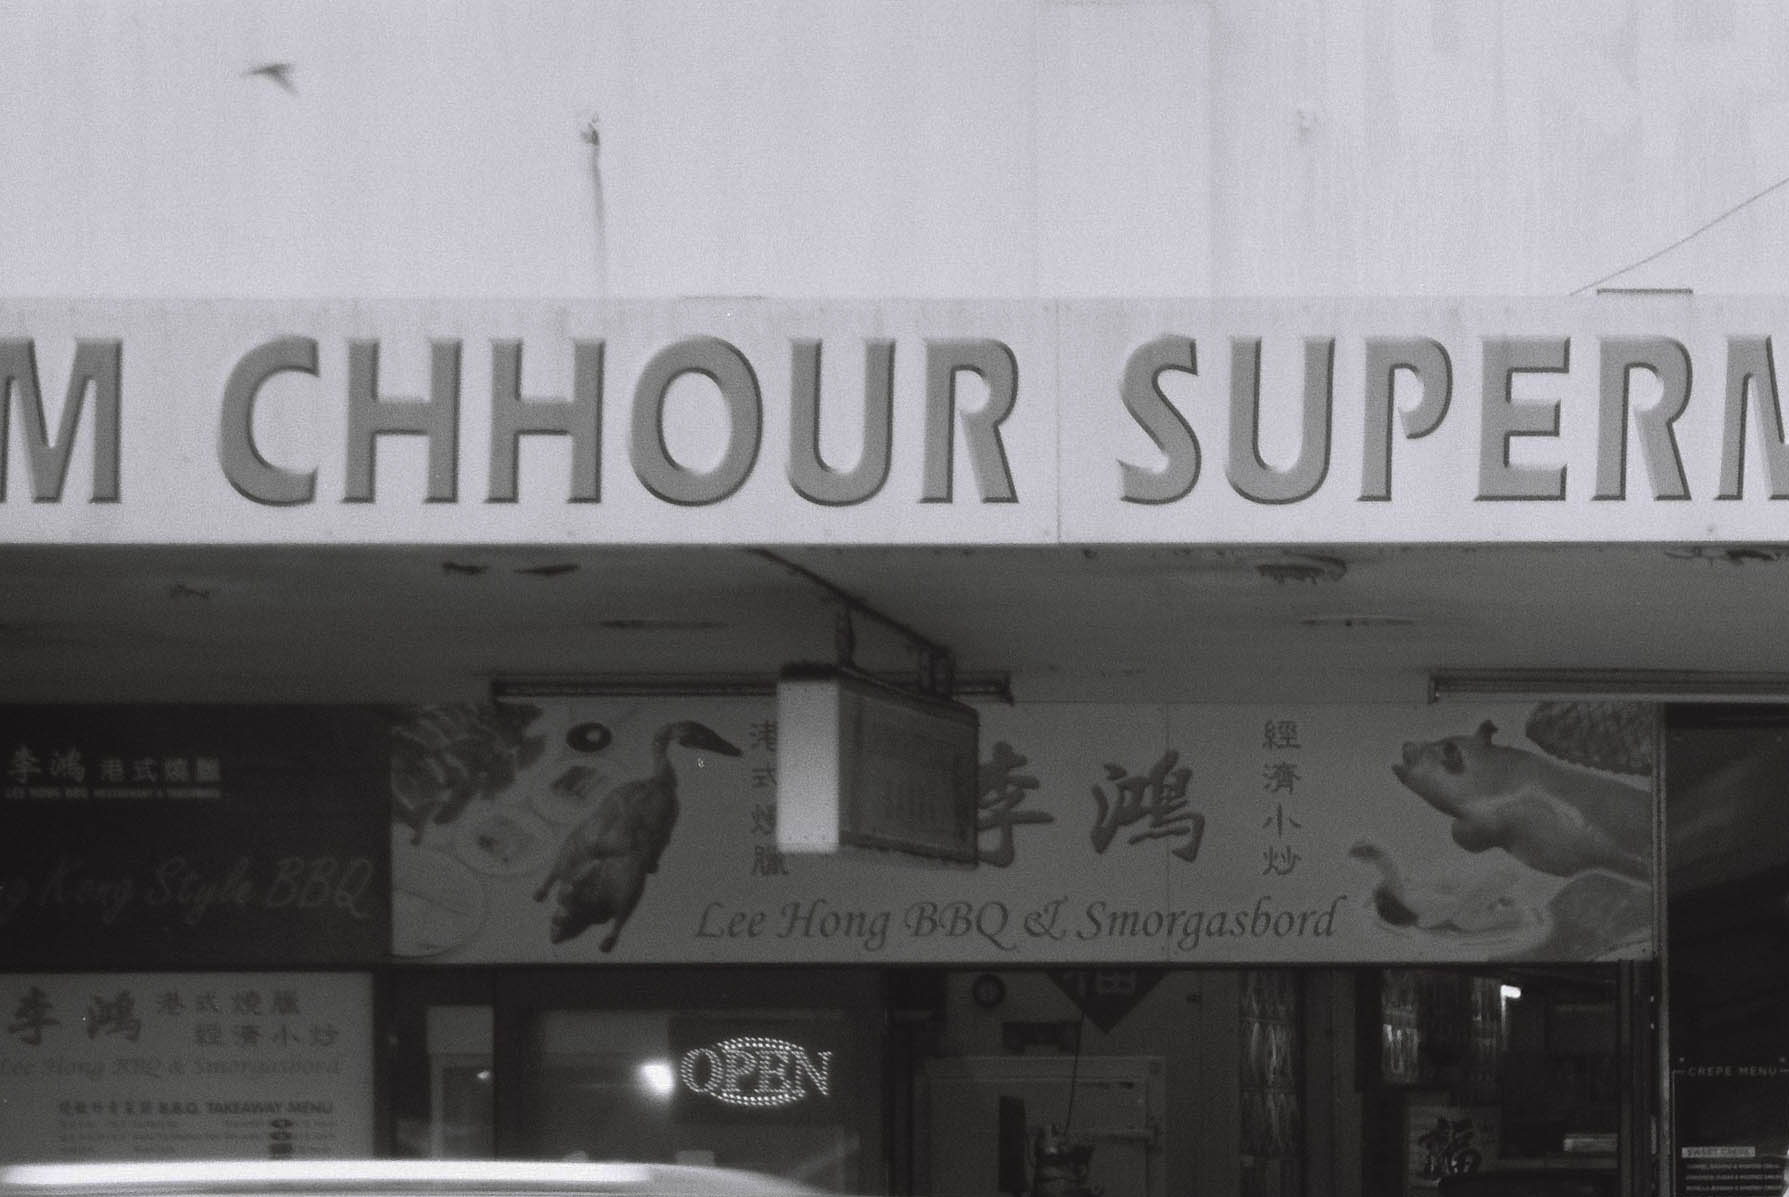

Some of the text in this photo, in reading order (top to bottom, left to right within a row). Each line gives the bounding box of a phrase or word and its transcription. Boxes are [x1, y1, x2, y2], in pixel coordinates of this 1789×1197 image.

[216, 335, 1020, 507] CHHOUR
[146, 855, 258, 926] Style
[265, 856, 374, 920] BBQ
[695, 900, 767, 939] Lee
[776, 897, 892, 952] Hong
[903, 899, 1021, 953] BBQ
[1075, 894, 1349, 953] Smorgasbord
[680, 1047, 833, 1097] OPEN
[1687, 1066, 1777, 1077] CREPE MENU
